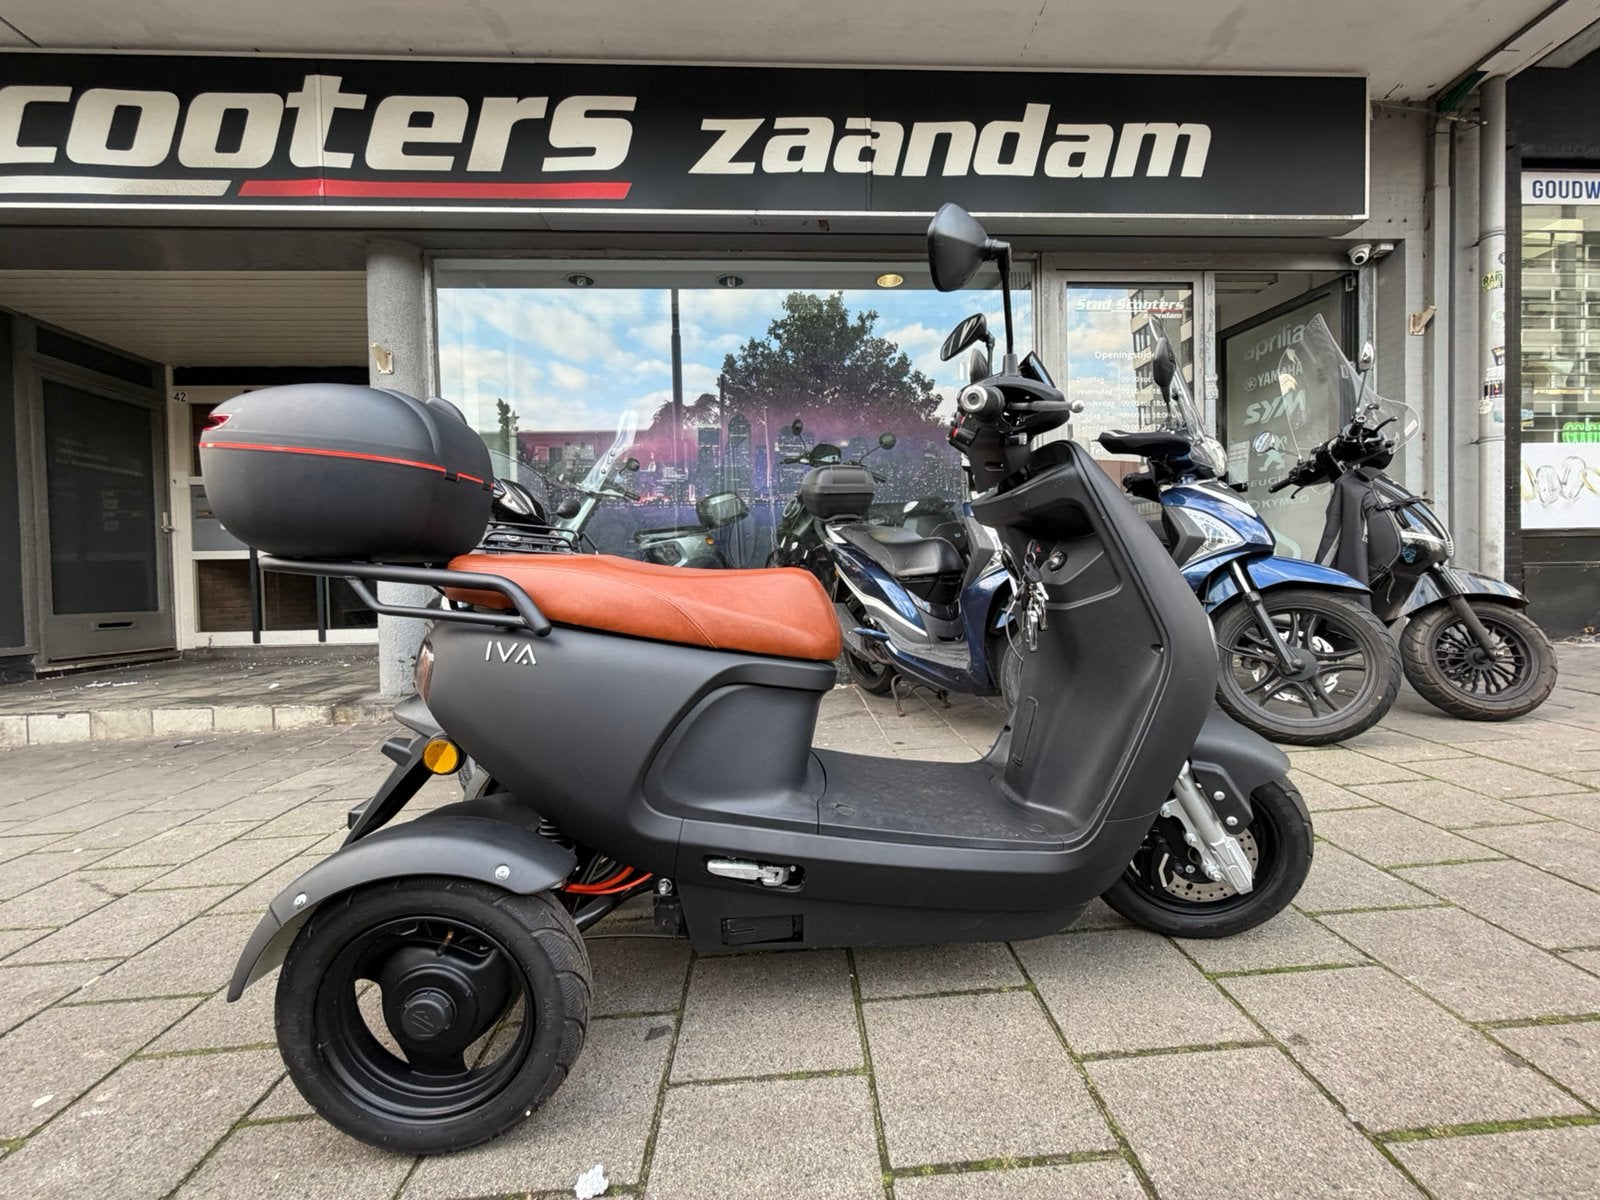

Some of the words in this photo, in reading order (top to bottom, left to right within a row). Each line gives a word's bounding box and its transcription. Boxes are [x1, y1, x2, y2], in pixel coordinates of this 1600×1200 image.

[688, 103, 1213, 178] zaandam
[1075, 298, 1112, 310] Stad
[1115, 298, 1184, 311] Scooters
[1244, 324, 1304, 361] aprilia
[1094, 350, 1155, 361] Openingstijd
[1257, 361, 1303, 387] YAMAHA
[174, 391, 187, 402] 42
[1243, 389, 1306, 426] SYM
[485, 640, 537, 665] IVA
